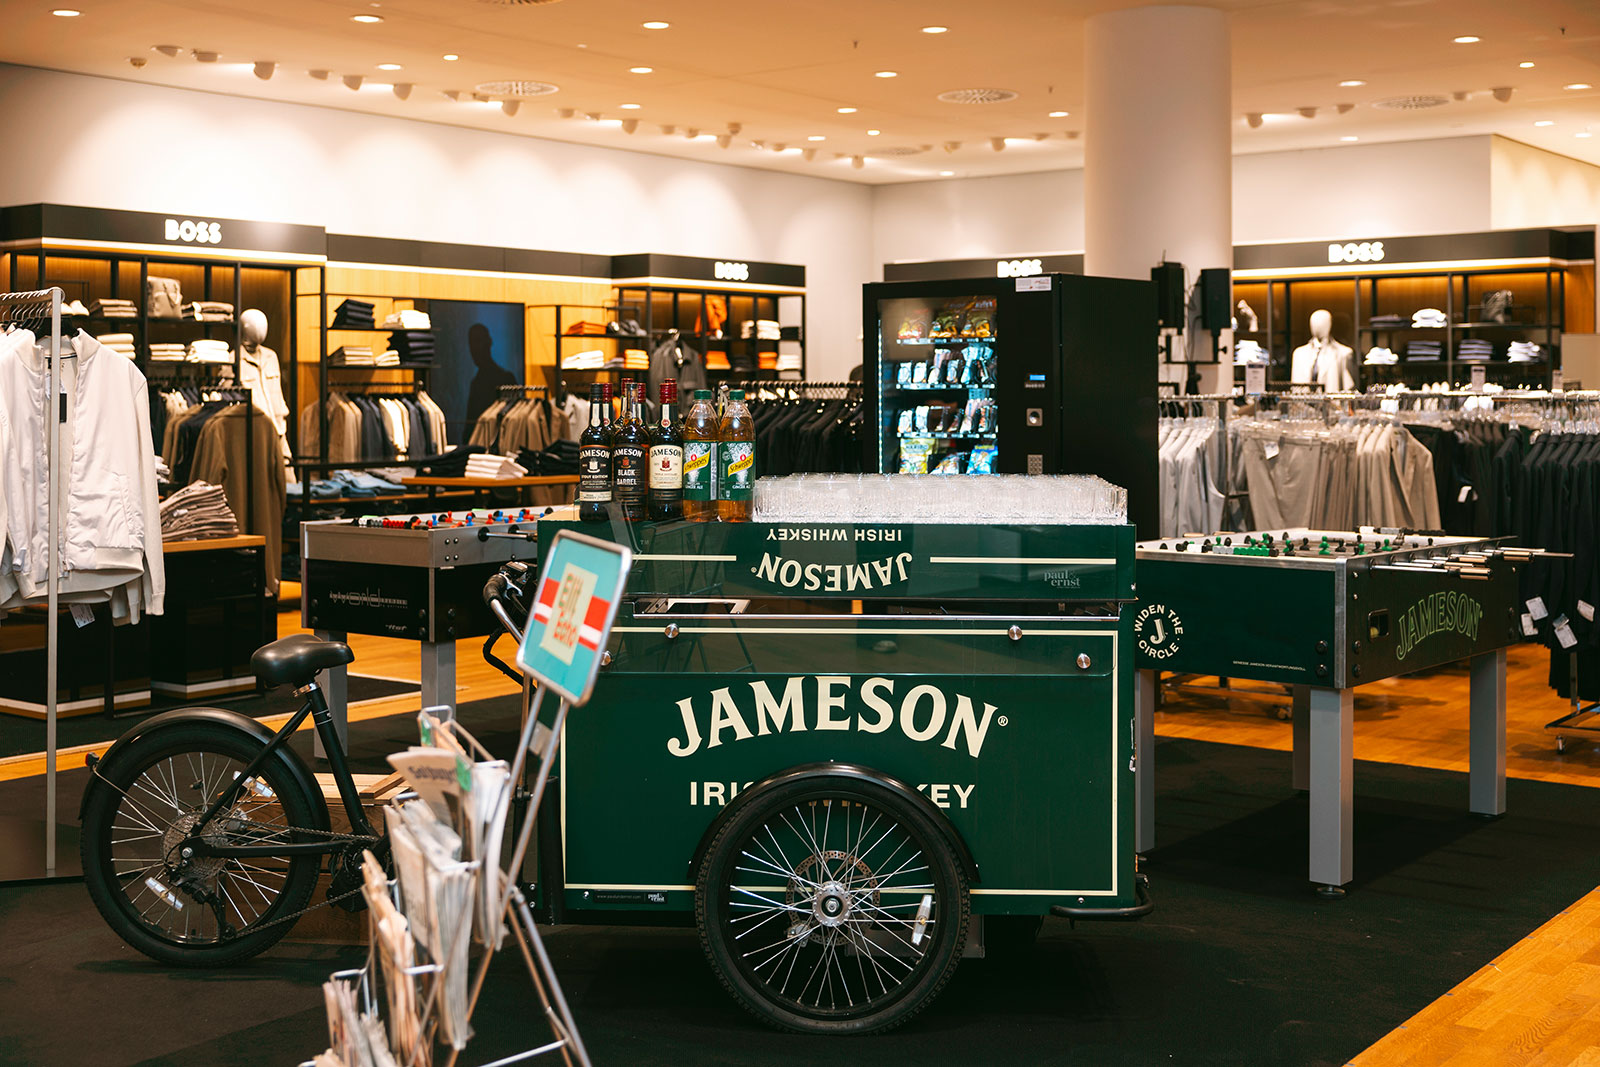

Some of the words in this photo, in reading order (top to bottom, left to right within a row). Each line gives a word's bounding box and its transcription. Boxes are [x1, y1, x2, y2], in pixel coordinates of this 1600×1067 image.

[164, 218, 222, 244] BOSS
[1328, 241, 1385, 263] BOSS
[580, 449, 610, 459] JAMESON
[651, 448, 682, 458] JAMESON
[766, 528, 848, 541] WHISKEY
[854, 529, 902, 541] IRISH
[756, 552, 913, 592] JAMESON
[1044, 569, 1068, 582] paul
[1050, 577, 1081, 587] ernst
[1134, 604, 1165, 632] WIDEN
[1168, 609, 1184, 635] THE
[1396, 590, 1481, 661] JAMESON
[1138, 640, 1179, 659] CIRCLE
[667, 675, 998, 758] JAMESON
[690, 781, 754, 806] IRI
